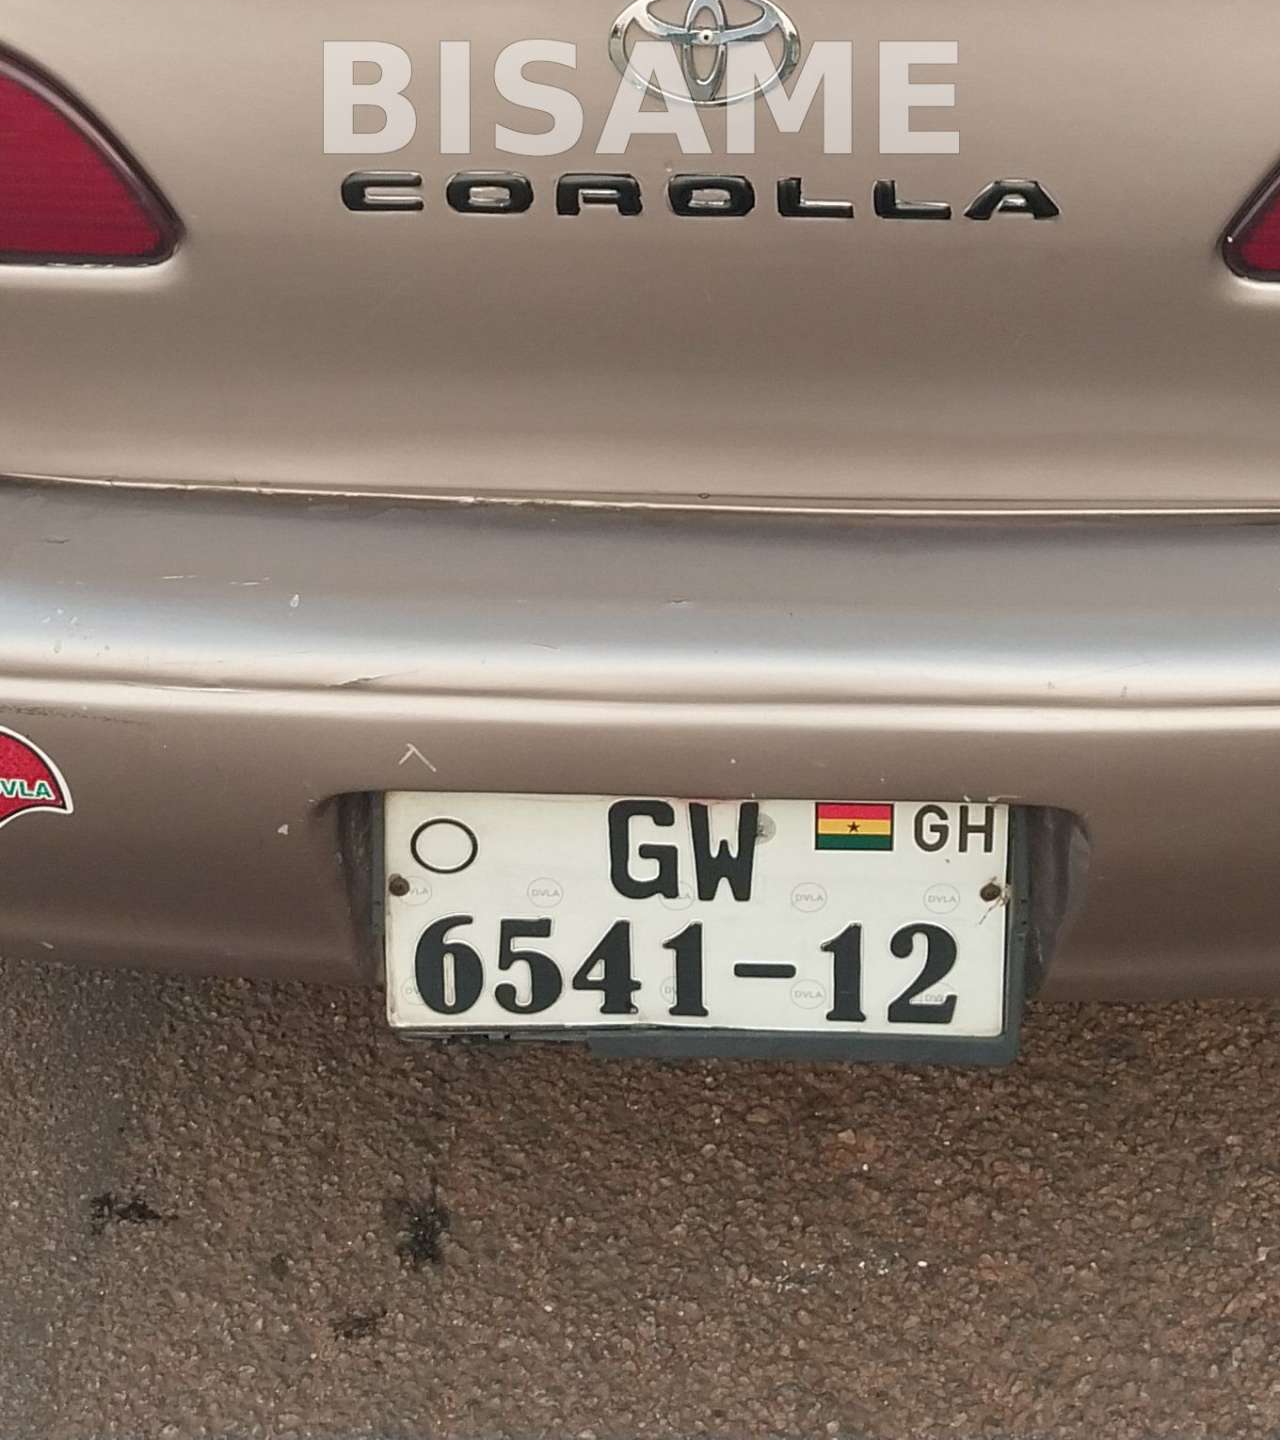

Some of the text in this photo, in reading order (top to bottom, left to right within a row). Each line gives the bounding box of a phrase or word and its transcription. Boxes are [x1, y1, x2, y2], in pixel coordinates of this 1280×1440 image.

[340, 169, 1061, 221] COROLLA
[608, 799, 995, 902] GW GH
[531, 888, 561, 898] DVLA
[794, 892, 825, 903] DVLA
[414, 914, 958, 1024] 6541-12
[794, 989, 824, 1000] DVLA
